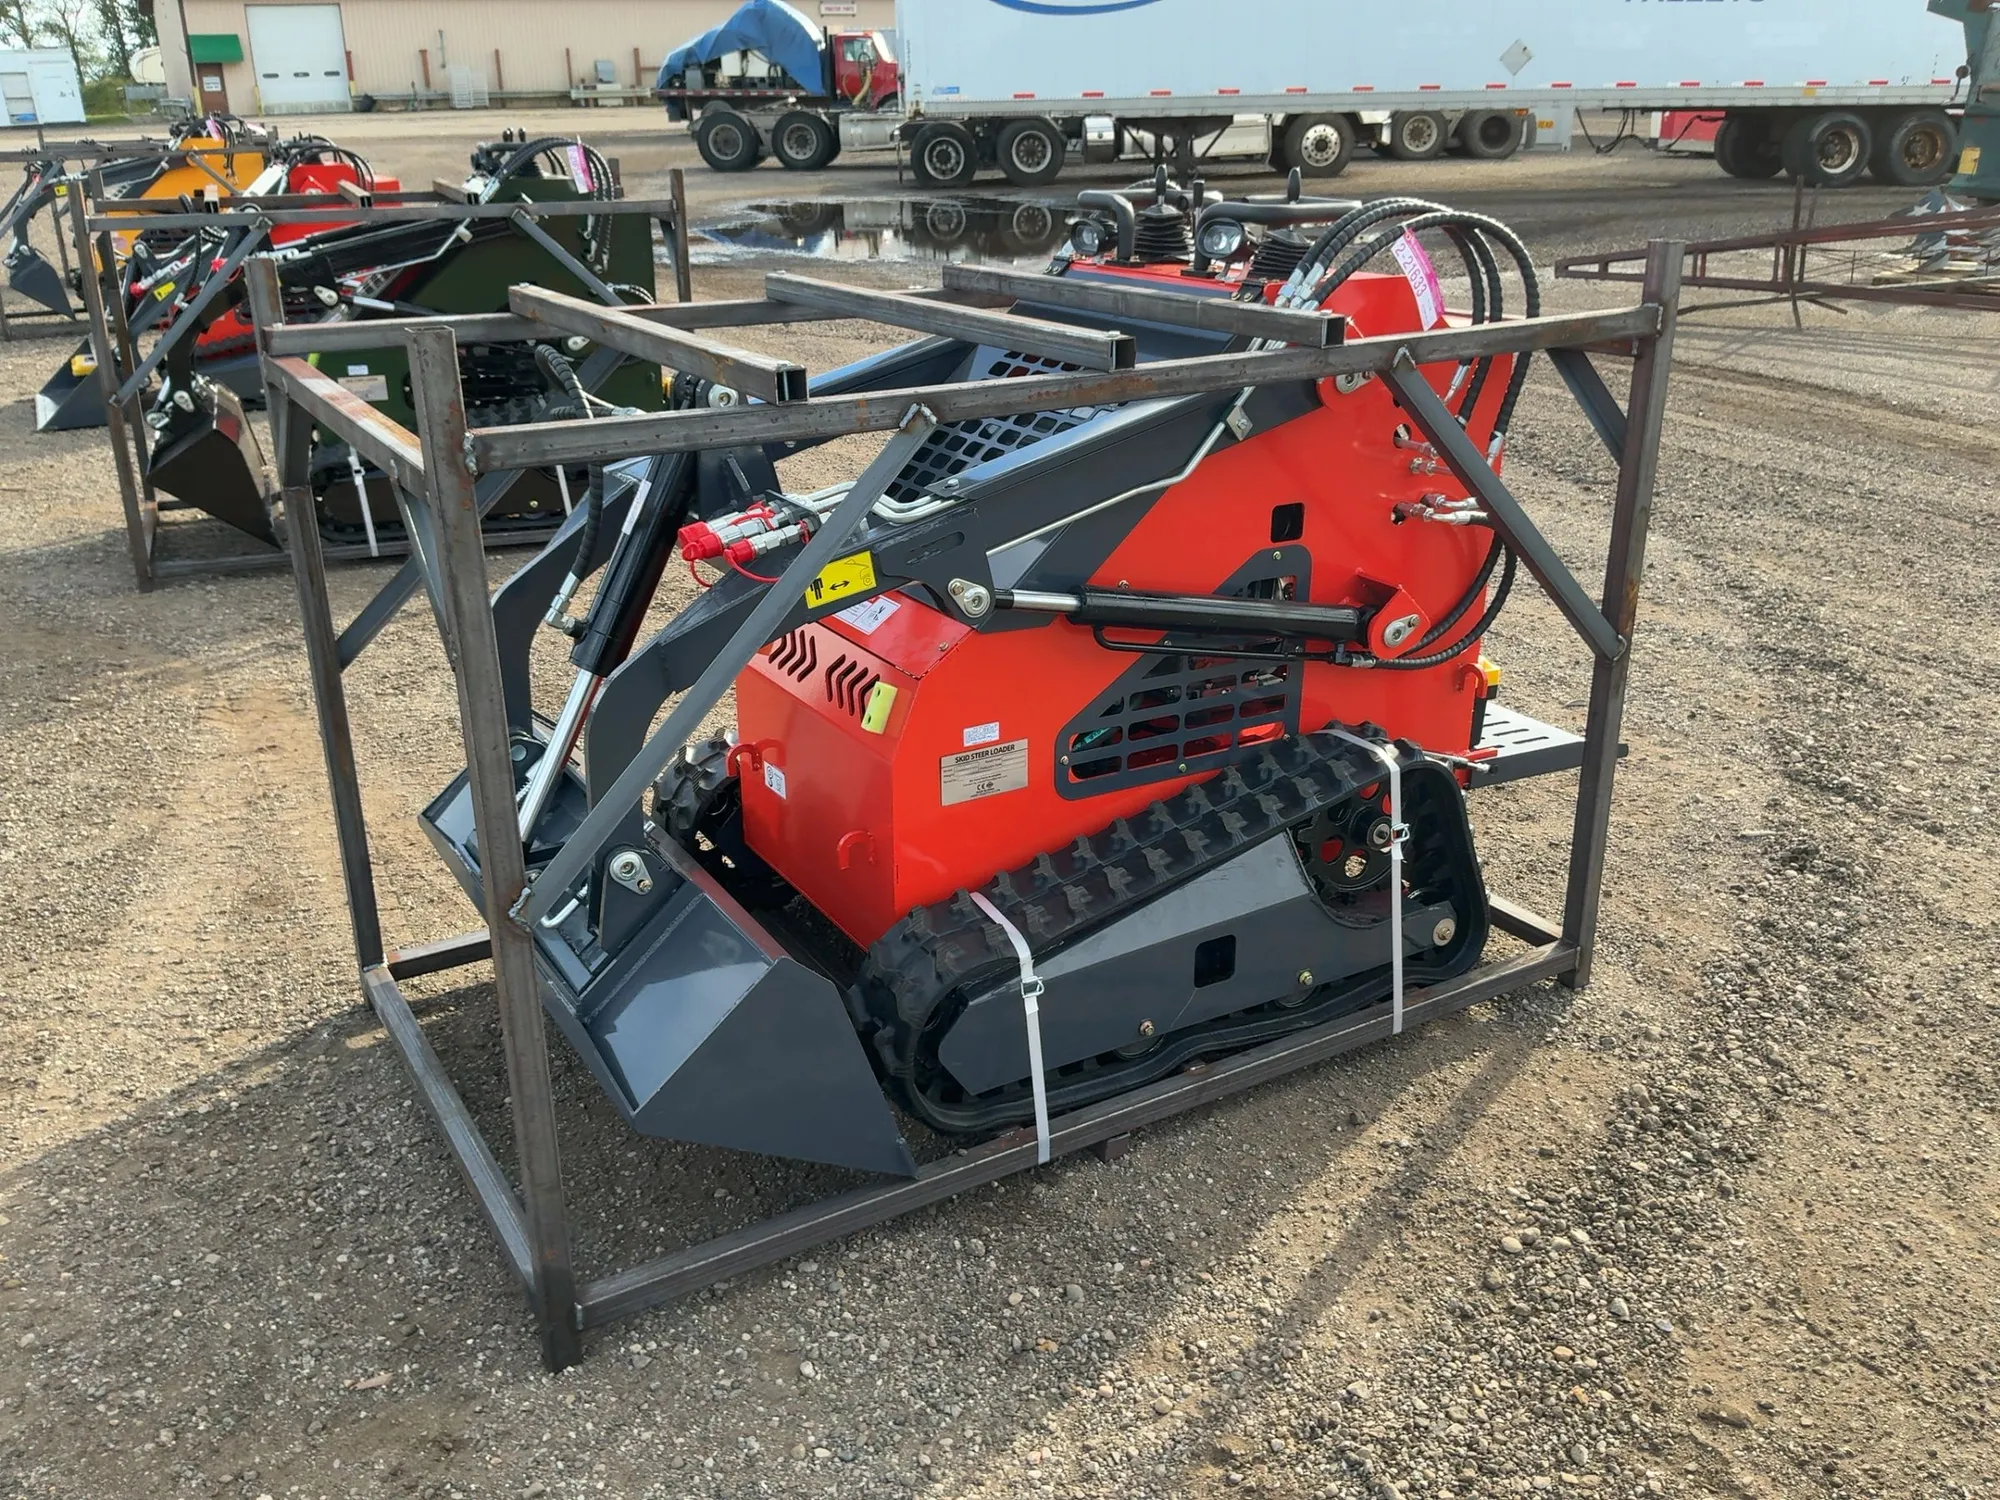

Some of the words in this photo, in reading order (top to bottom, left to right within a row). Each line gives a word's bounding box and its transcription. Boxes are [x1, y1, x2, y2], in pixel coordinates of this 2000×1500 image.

[1394, 243, 1428, 297] 2-21633
[955, 754, 970, 763] SKID
[971, 750, 989, 760] STEER
[990, 744, 1015, 755] LOADER
